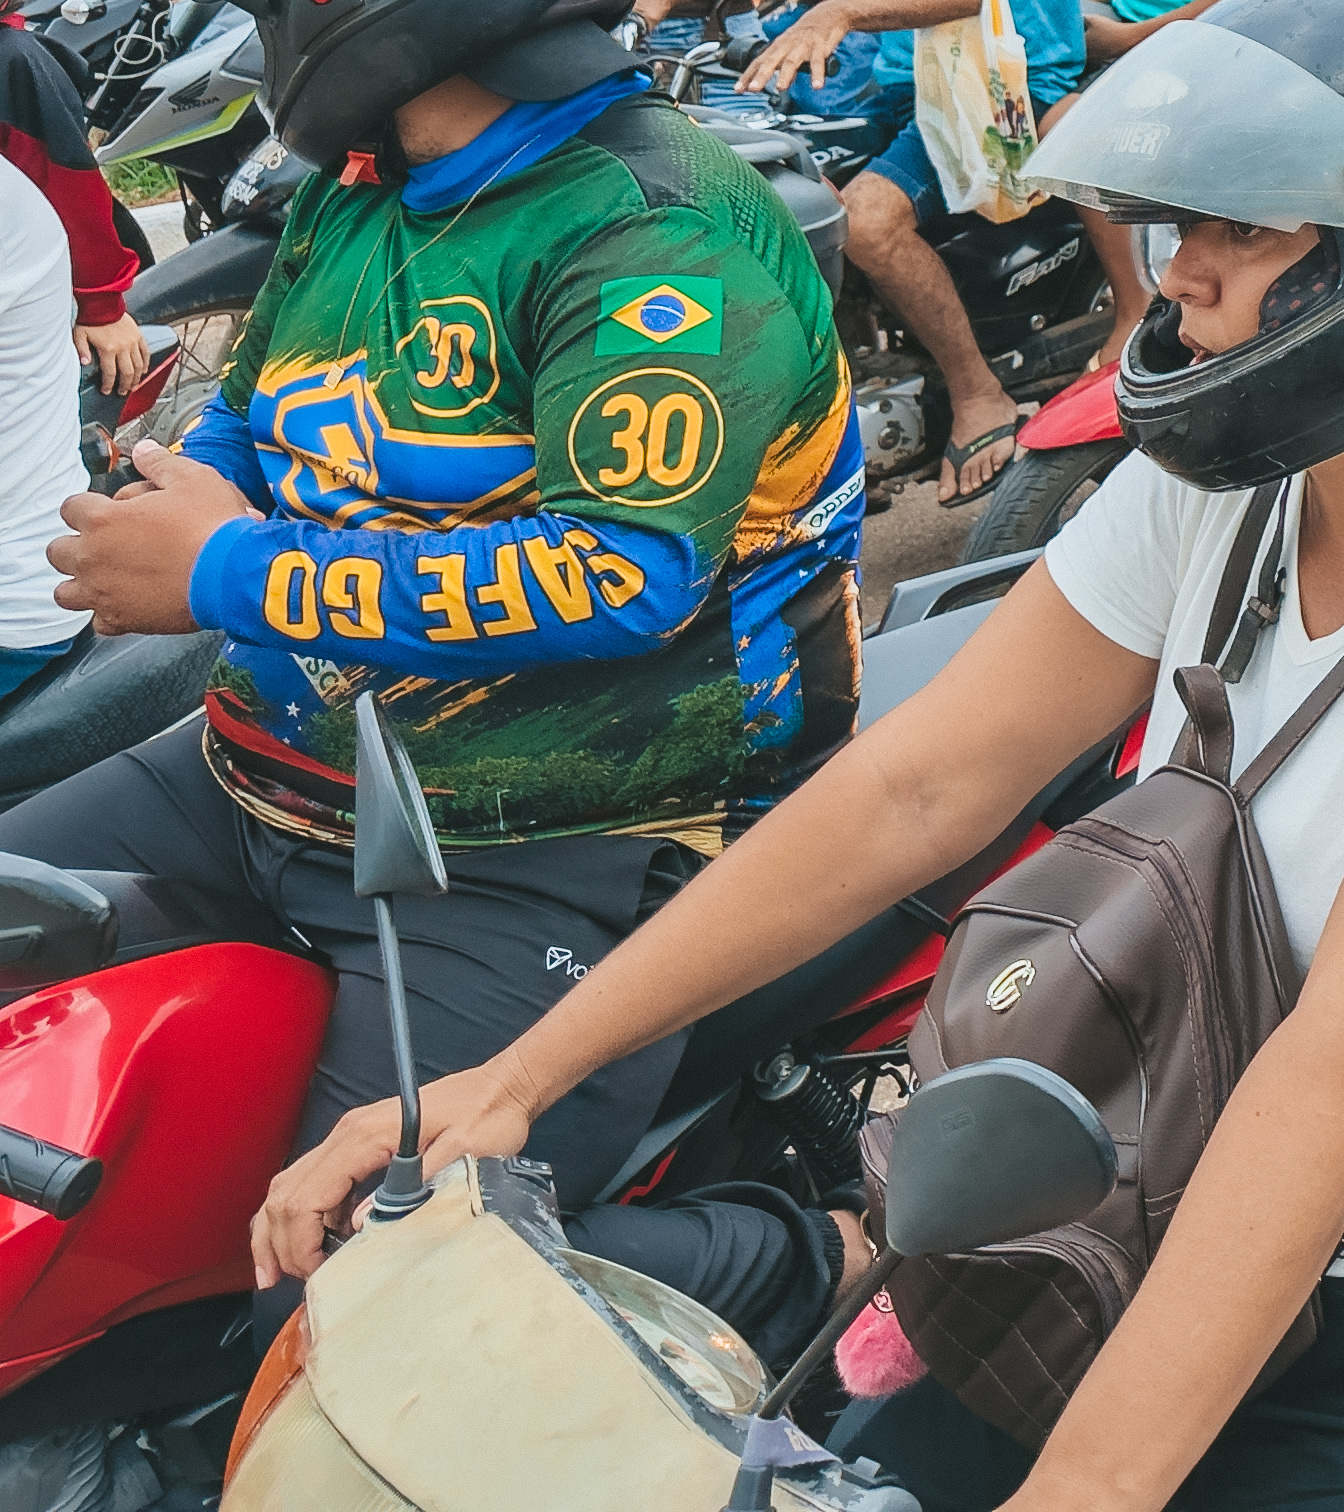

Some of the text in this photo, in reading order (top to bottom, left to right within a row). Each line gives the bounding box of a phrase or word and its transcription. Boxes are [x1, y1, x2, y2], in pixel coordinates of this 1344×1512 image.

[598, 392, 704, 487] 30
[263, 528, 646, 643] SAFE GO
